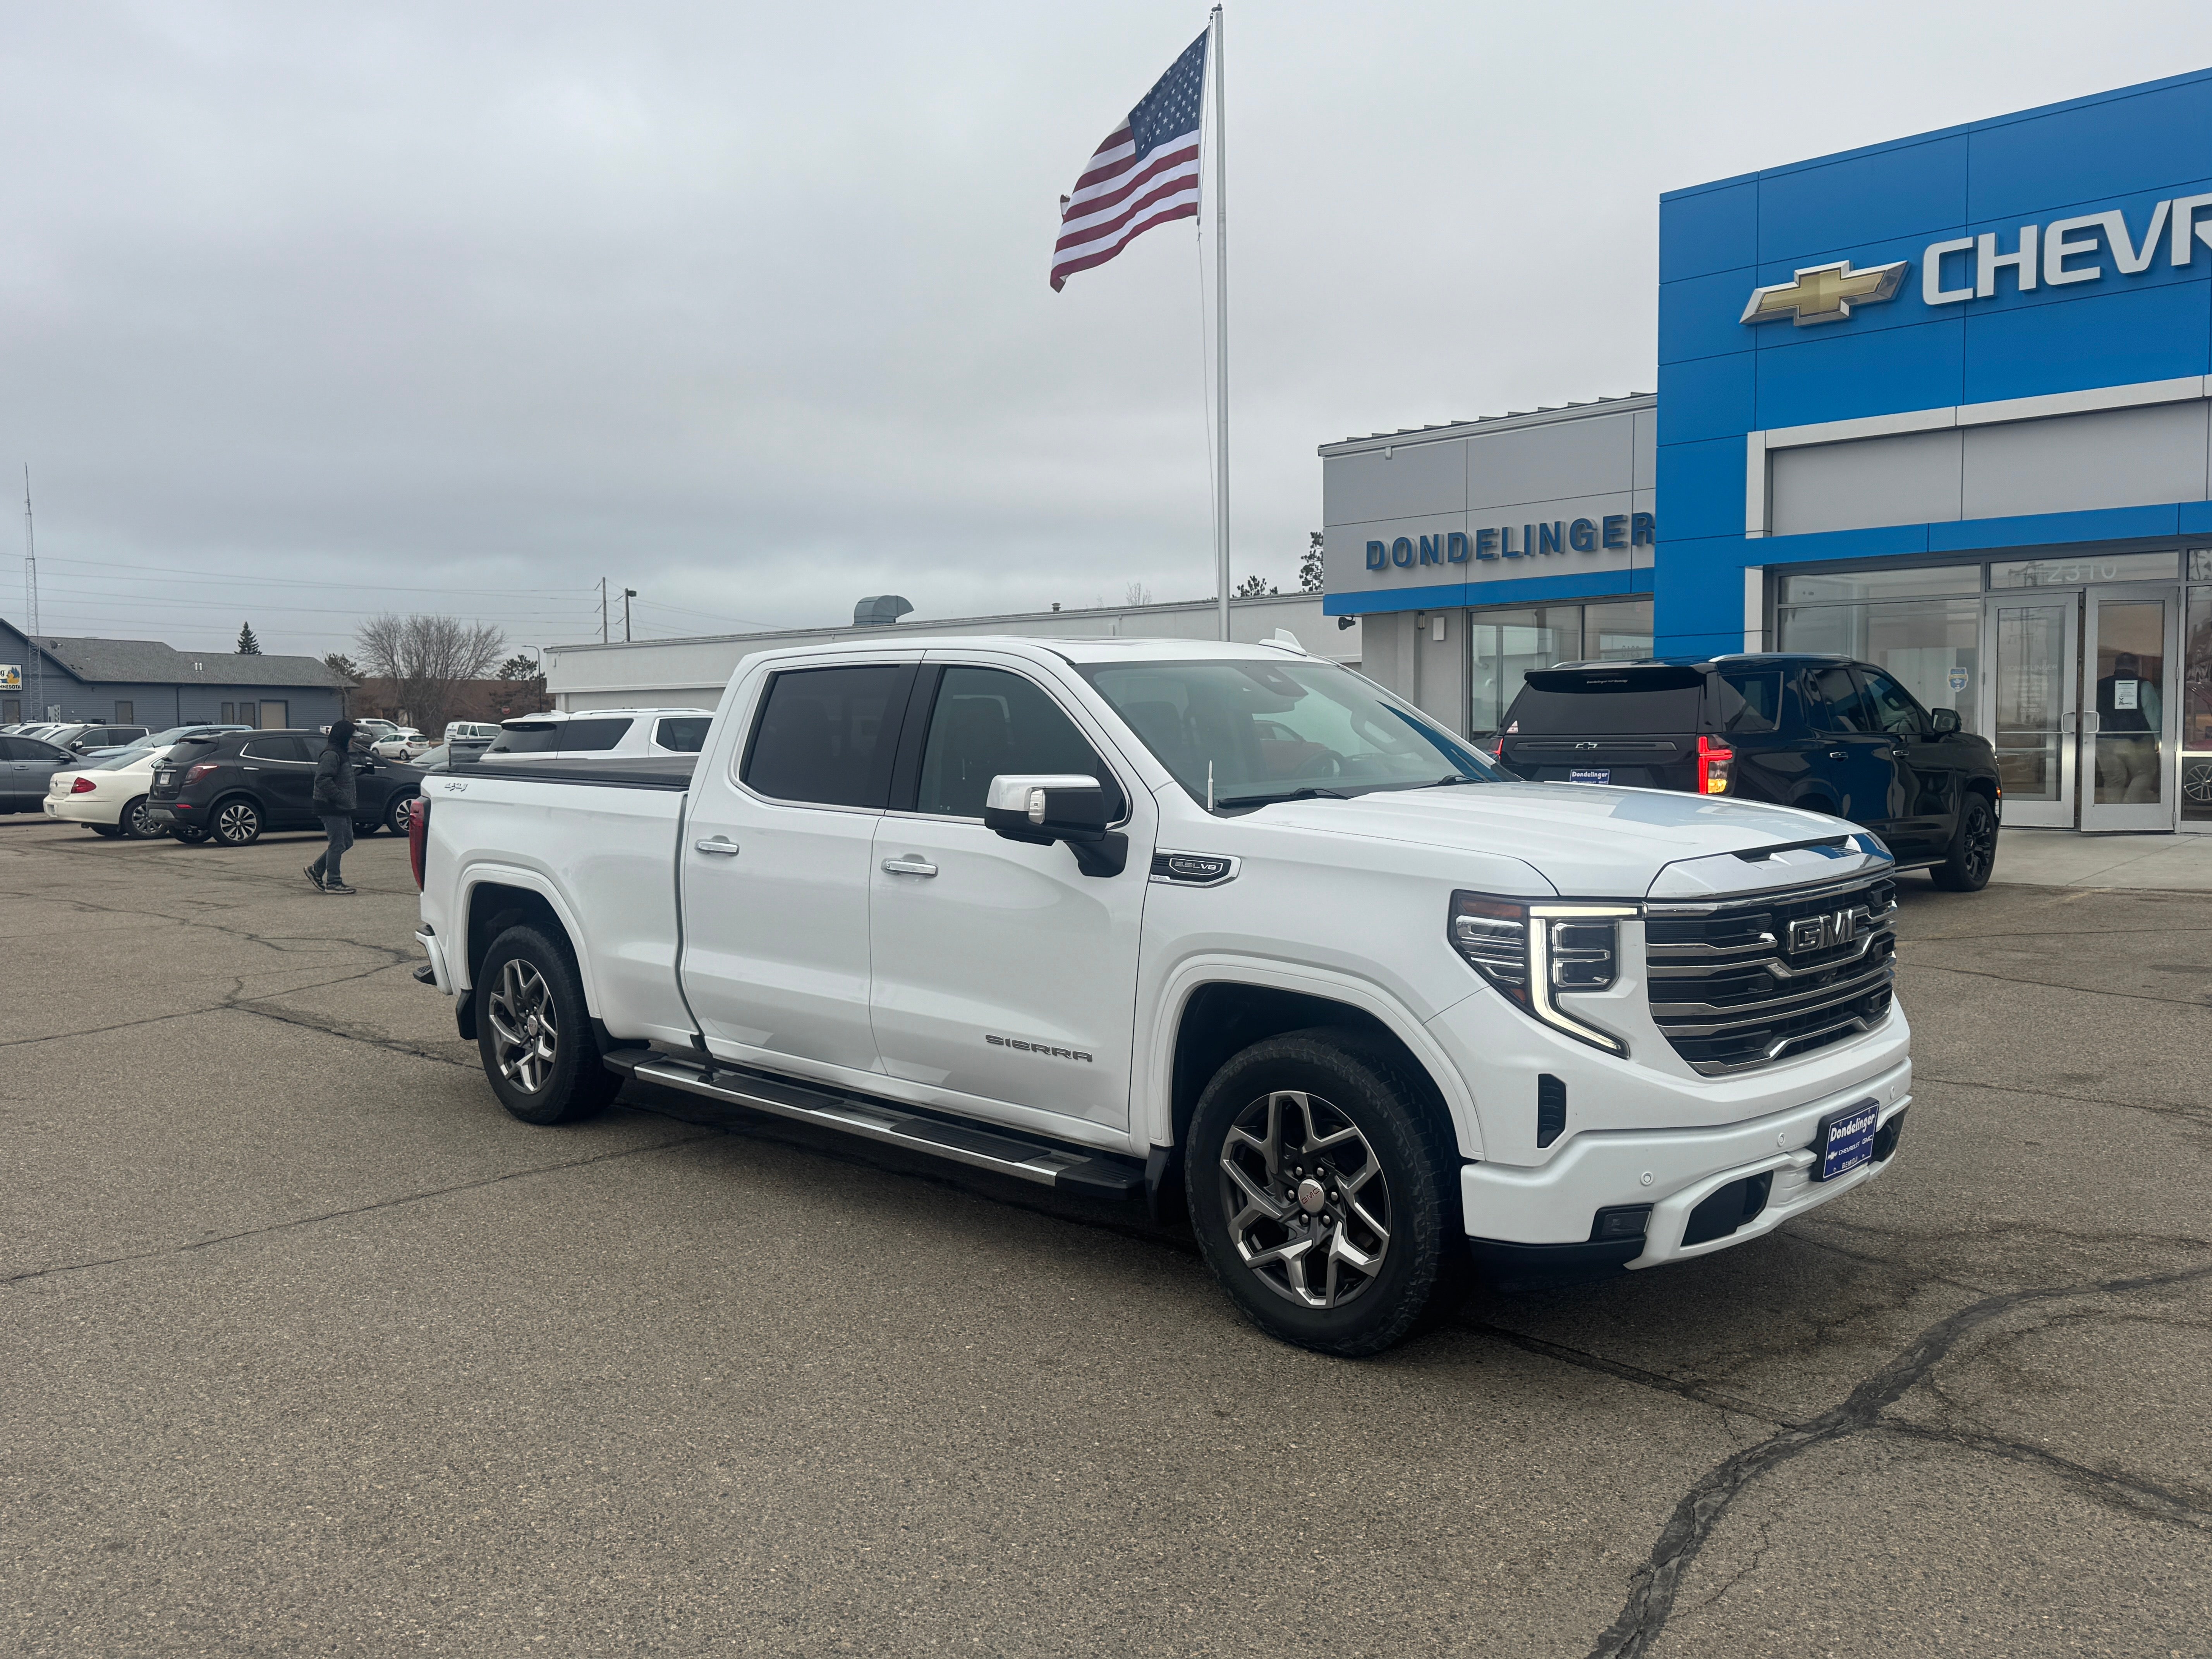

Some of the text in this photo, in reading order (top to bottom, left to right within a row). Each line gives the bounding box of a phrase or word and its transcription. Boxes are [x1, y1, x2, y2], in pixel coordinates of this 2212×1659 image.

[1366, 512, 1655, 570] DONDELINGER
[1787, 904, 1870, 955] GMC
[985, 1034, 1092, 1062] SIERRA
[1830, 1114, 1875, 1142] Dondelinger
[1838, 1135, 1873, 1155] CHEVROLET GMC
[1301, 1187, 1320, 1204] GMC
